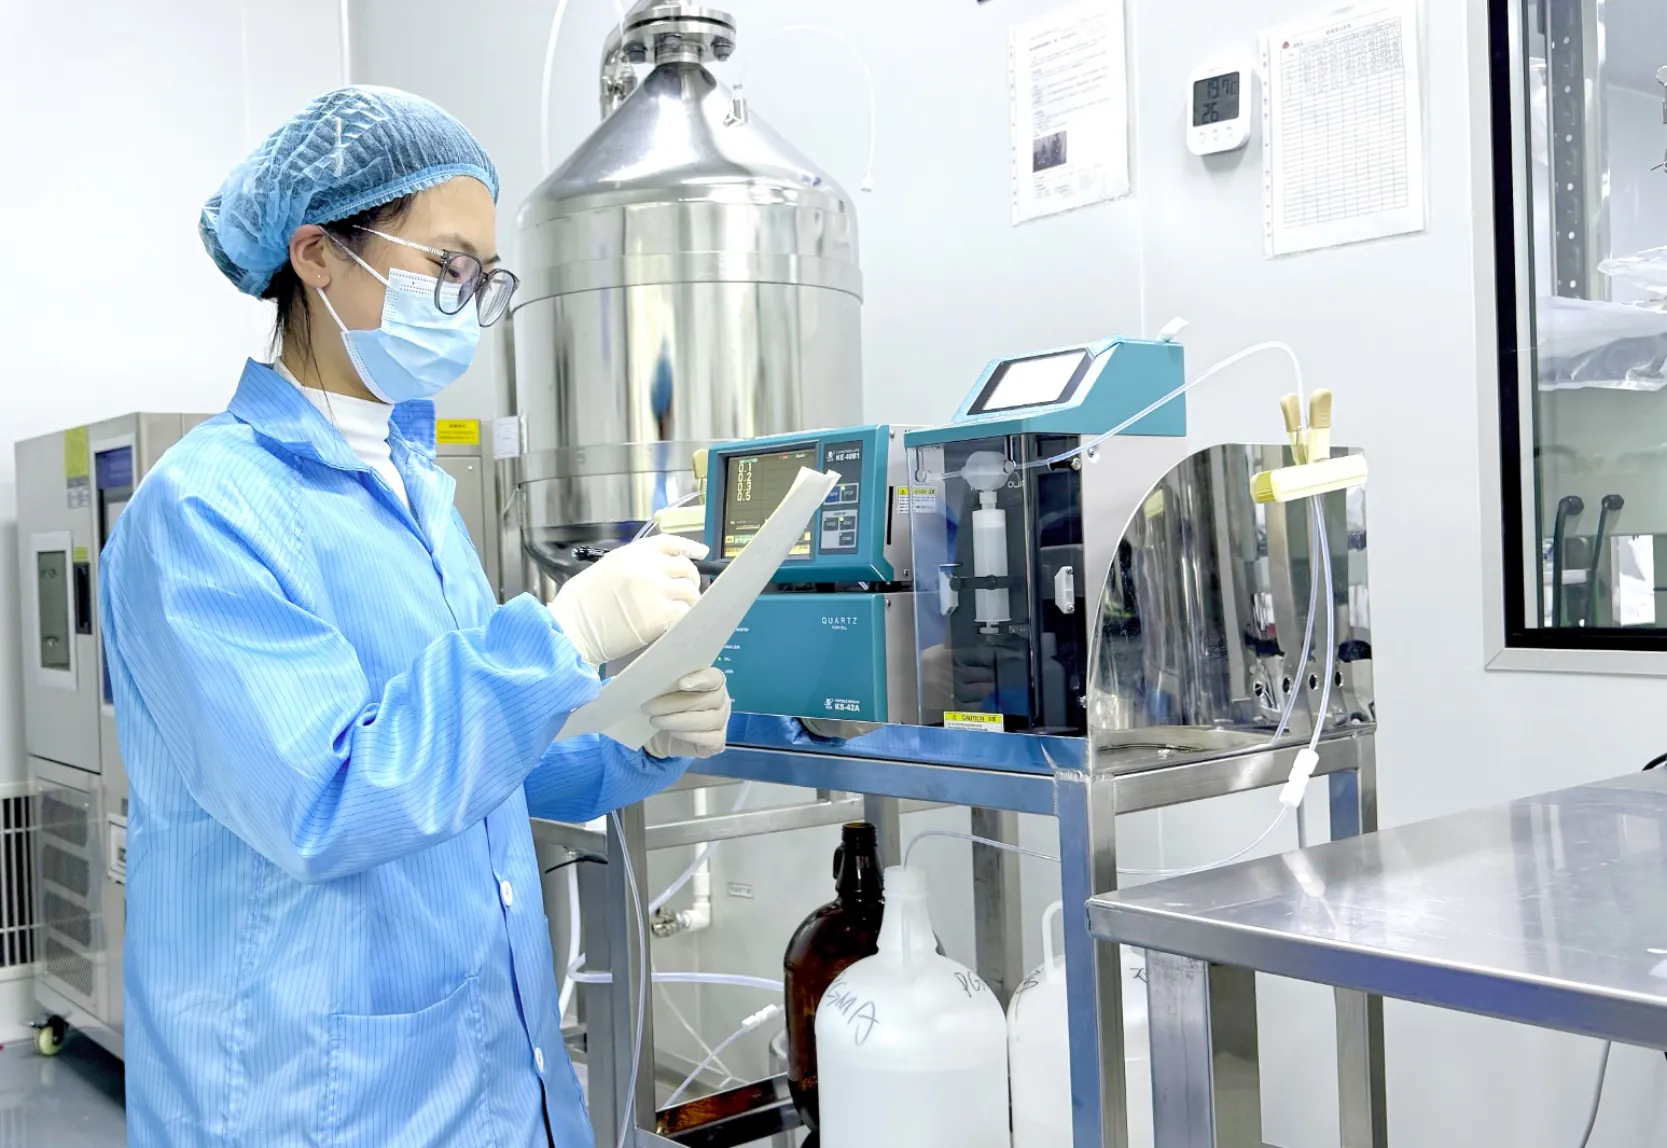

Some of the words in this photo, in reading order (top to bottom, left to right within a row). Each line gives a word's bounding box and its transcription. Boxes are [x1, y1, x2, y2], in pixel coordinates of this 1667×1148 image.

[1201, 101, 1219, 124] 26
[738, 462, 752, 473] 0.1
[738, 472, 752, 482] 0.2
[737, 482, 752, 492] 0.3
[737, 492, 751, 502] 0.5
[821, 616, 858, 625] QUARTZ
[962, 714, 985, 723] CAUTION
